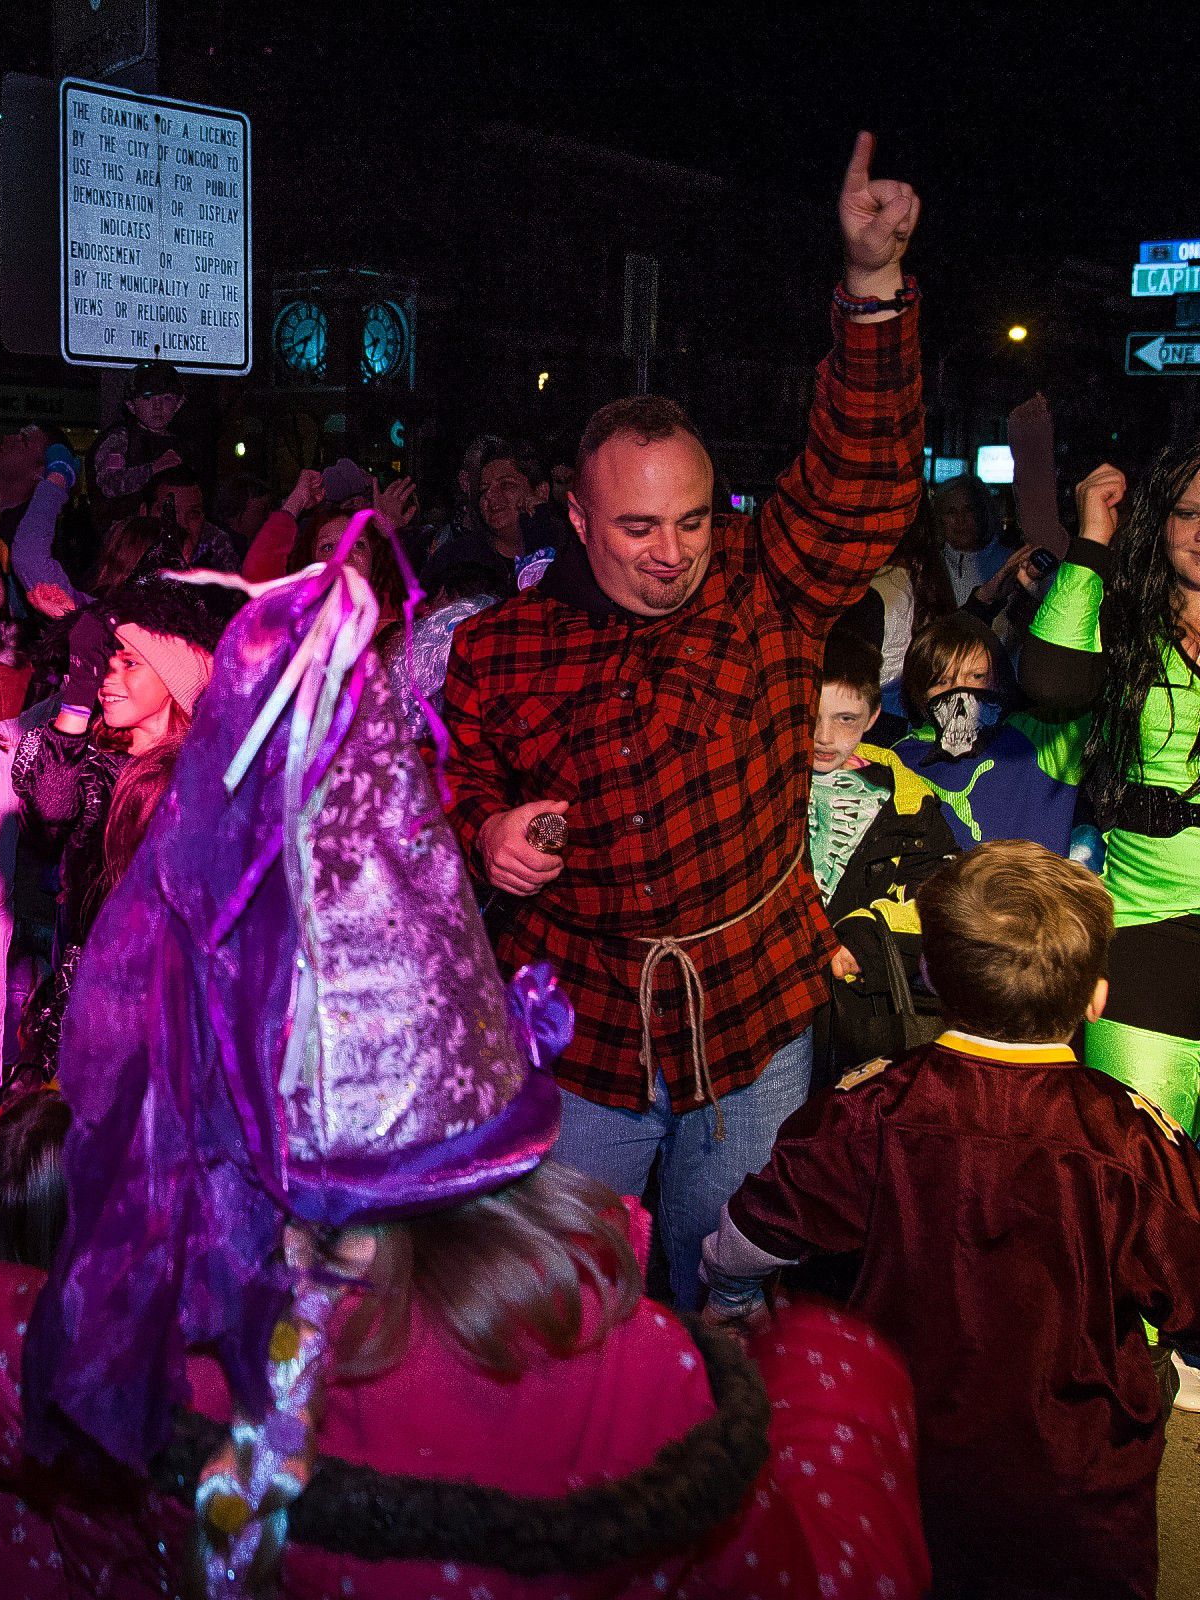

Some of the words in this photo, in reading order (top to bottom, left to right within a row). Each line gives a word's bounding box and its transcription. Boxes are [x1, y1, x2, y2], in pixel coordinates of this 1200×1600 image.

[72, 101, 90, 121] THE
[101, 106, 150, 132] GRANTING
[160, 118, 173, 136] OF
[181, 123, 190, 139] A
[200, 125, 238, 148] LICENSE
[72, 130, 85, 148] BY
[99, 134, 116, 153] THE
[127, 139, 150, 159] CITY
[157, 144, 170, 162] OF
[175, 147, 219, 170] CONCORD
[227, 156, 239, 173] TO
[72, 157, 92, 177] USE
[101, 162, 124, 182] THIS
[135, 168, 161, 188] AREA
[174, 174, 193, 193] FOR
[205, 179, 239, 199] PUBLIC
[72, 185, 154, 214] DEMONSTRATION
[171, 200, 184, 218] OR
[199, 204, 239, 225] DISPLAY
[100, 217, 151, 240] INDICATES
[173, 228, 214, 249] NEITHER
[70, 240, 141, 267] ENDORSEMENT
[159, 252, 173, 270] OR
[194, 256, 239, 277] SUPPORT
[74, 269, 87, 287] BY
[95, 271, 113, 290] THE
[119, 274, 189, 298] MUNICIPALITY
[198, 283, 211, 300] OF
[221, 285, 239, 303] THE
[73, 297, 103, 317] VIEWS
[115, 301, 128, 319] OR
[137, 304, 188, 324] RELIGIOUS
[200, 309, 240, 328] BELIEFS
[103, 328, 117, 345] OF
[130, 330, 149, 348] THE
[1158, 344, 1195, 362] ONE
